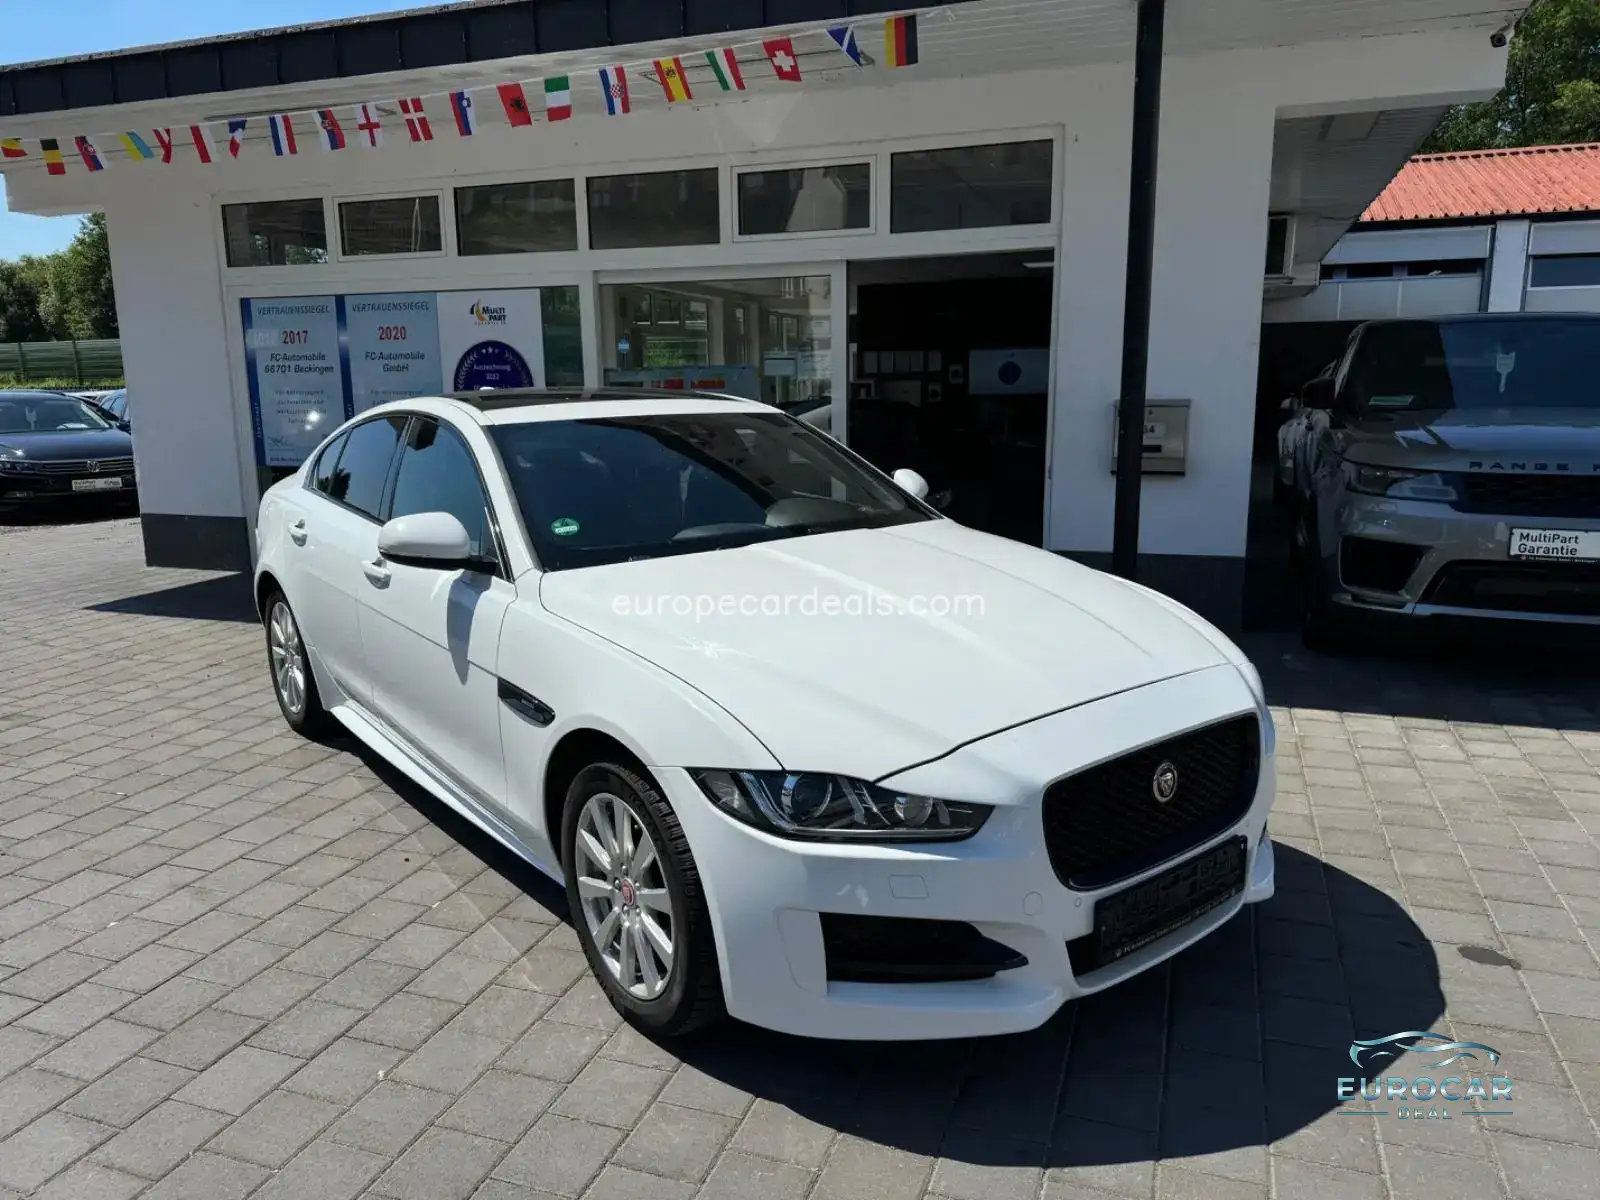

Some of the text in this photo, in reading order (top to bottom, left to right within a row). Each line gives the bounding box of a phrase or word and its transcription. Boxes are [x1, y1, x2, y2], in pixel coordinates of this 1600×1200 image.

[257, 305, 330, 316] VERTRAUENSSIEGEL
[351, 301, 430, 312] VERTRAUENSSIEGEL
[282, 330, 309, 345] 2017
[378, 326, 407, 341] 2020
[269, 351, 326, 362] FC-Automobile
[365, 351, 425, 361] FC-Automobile
[264, 362, 334, 376] 66701 Beckingen
[382, 363, 410, 373] GmbH
[1468, 461, 1570, 472] RANGE
[1518, 531, 1580, 545] MultiPart
[1517, 543, 1579, 557] Garantie
